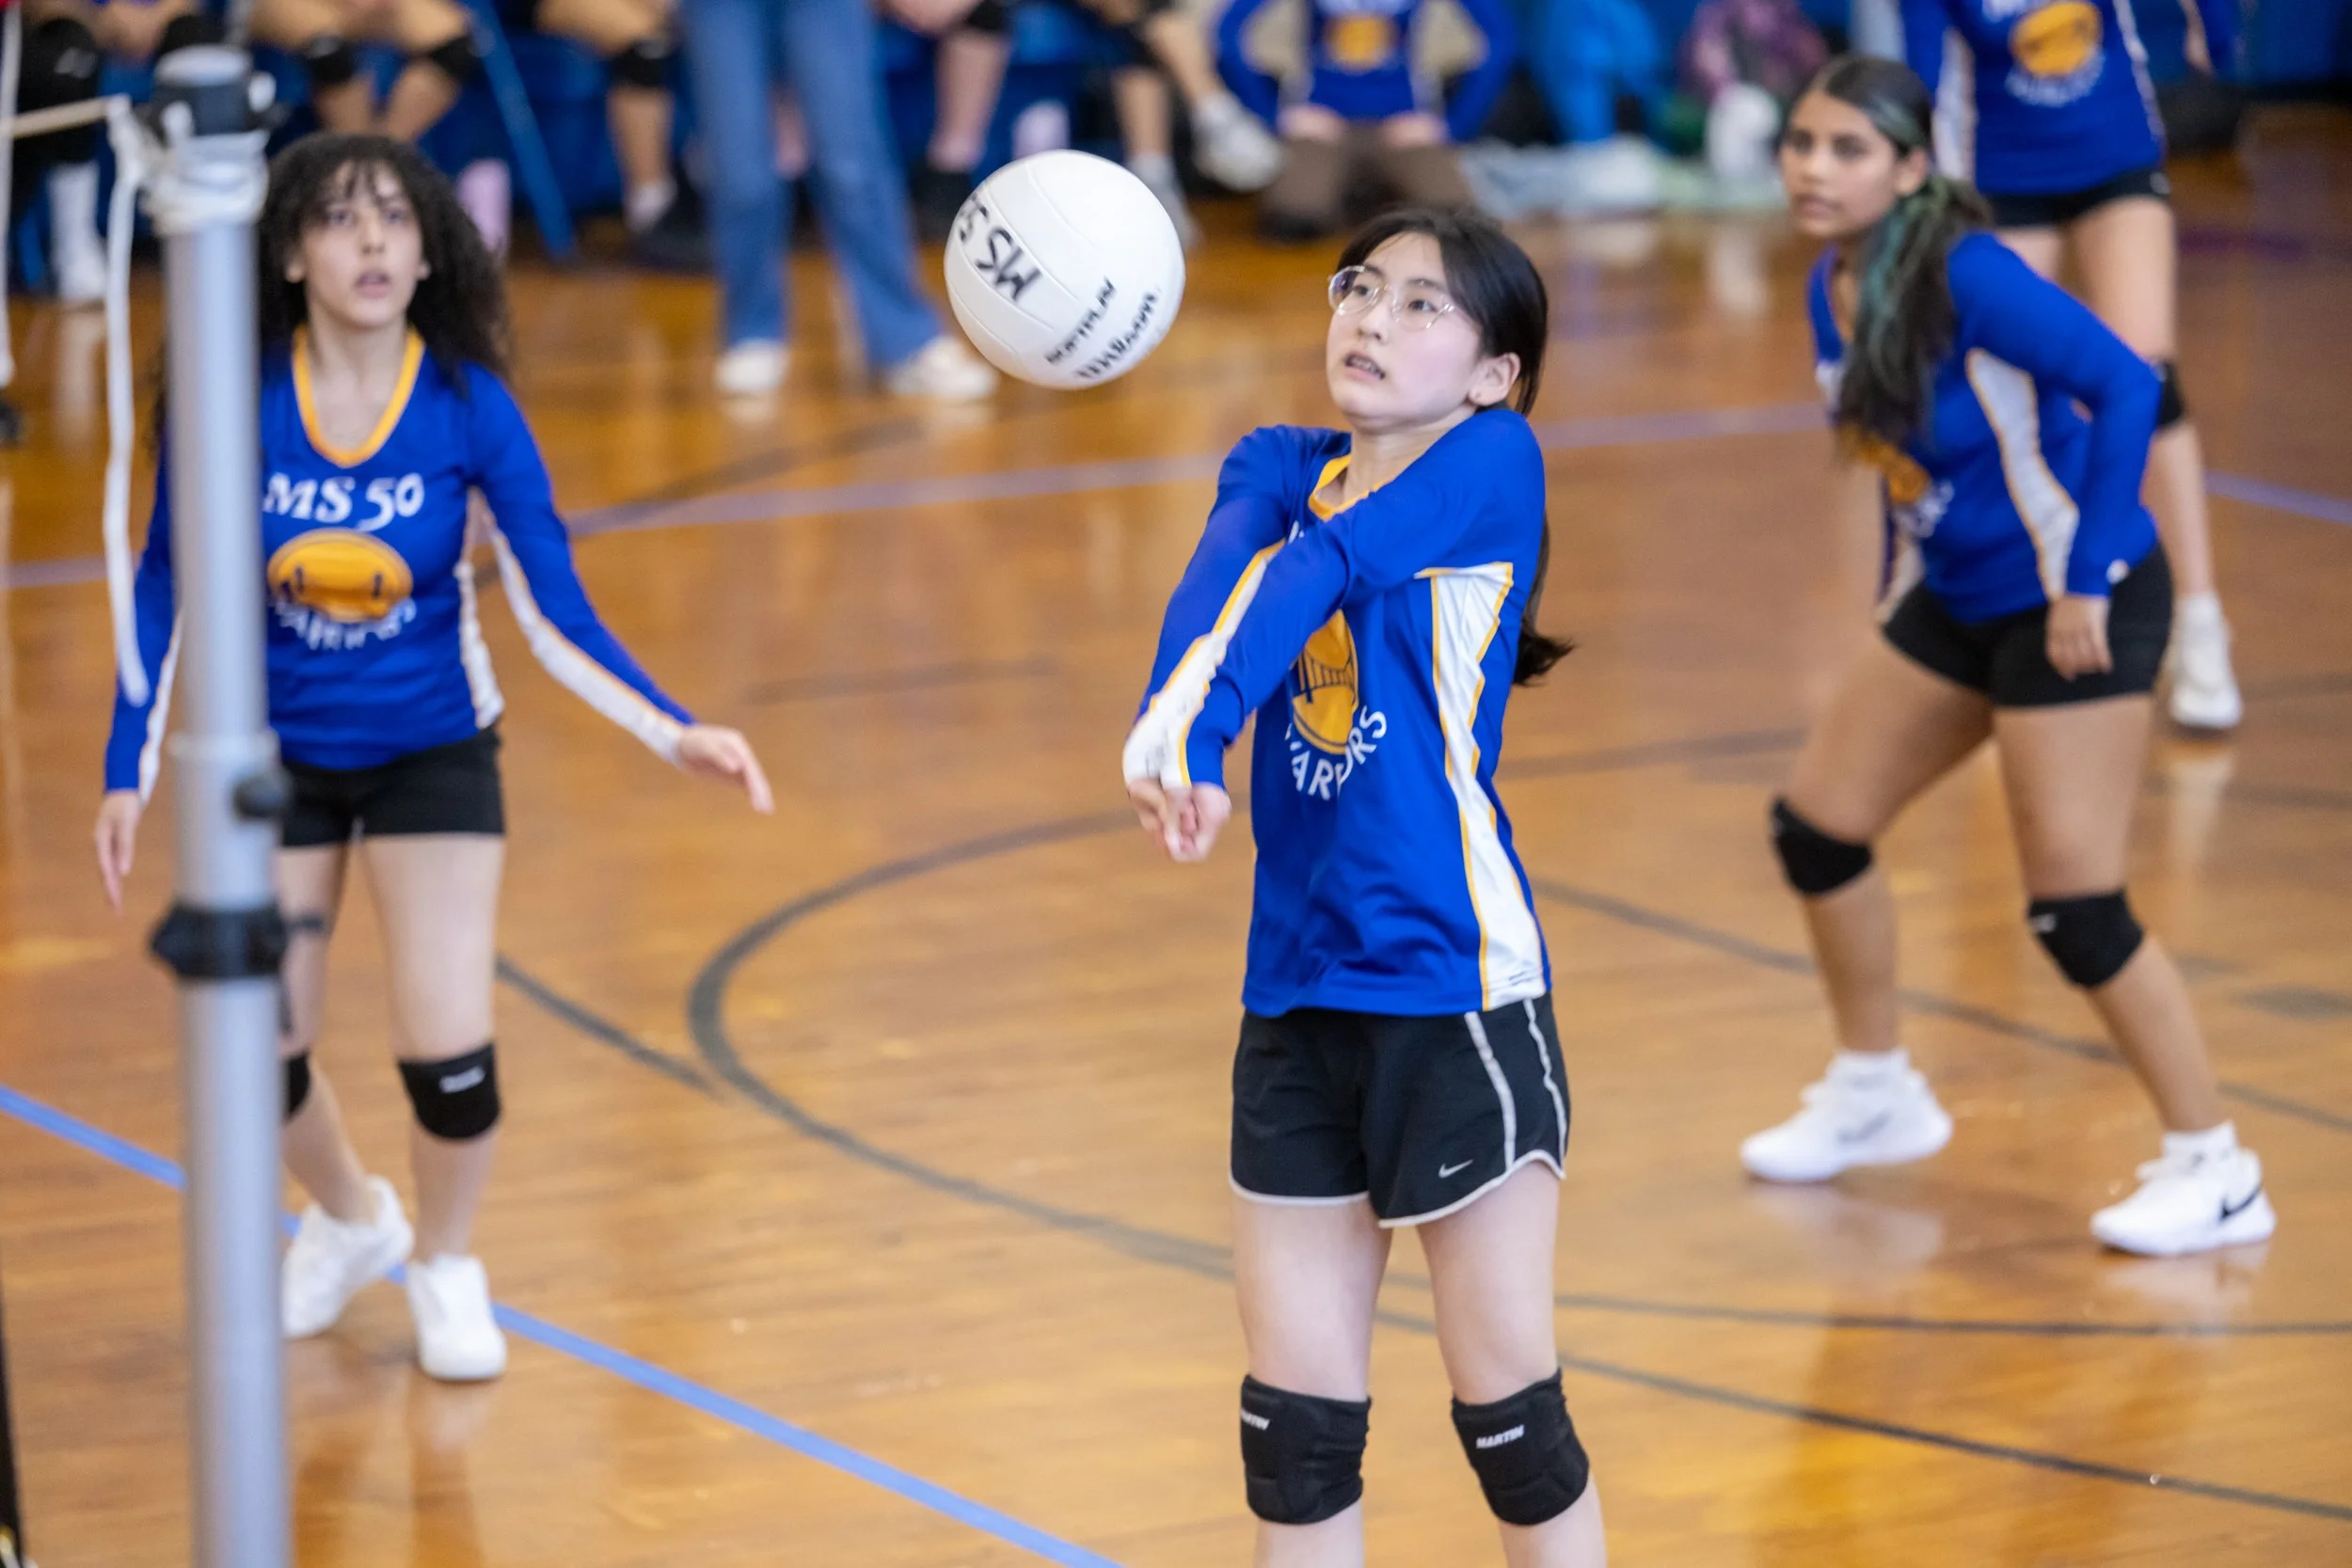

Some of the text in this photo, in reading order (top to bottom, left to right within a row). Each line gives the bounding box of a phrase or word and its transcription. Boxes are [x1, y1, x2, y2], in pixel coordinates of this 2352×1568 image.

[976, 226, 1044, 302] MS
[262, 471, 425, 532] MS 50
[1475, 1423, 1525, 1449] MARTIN
